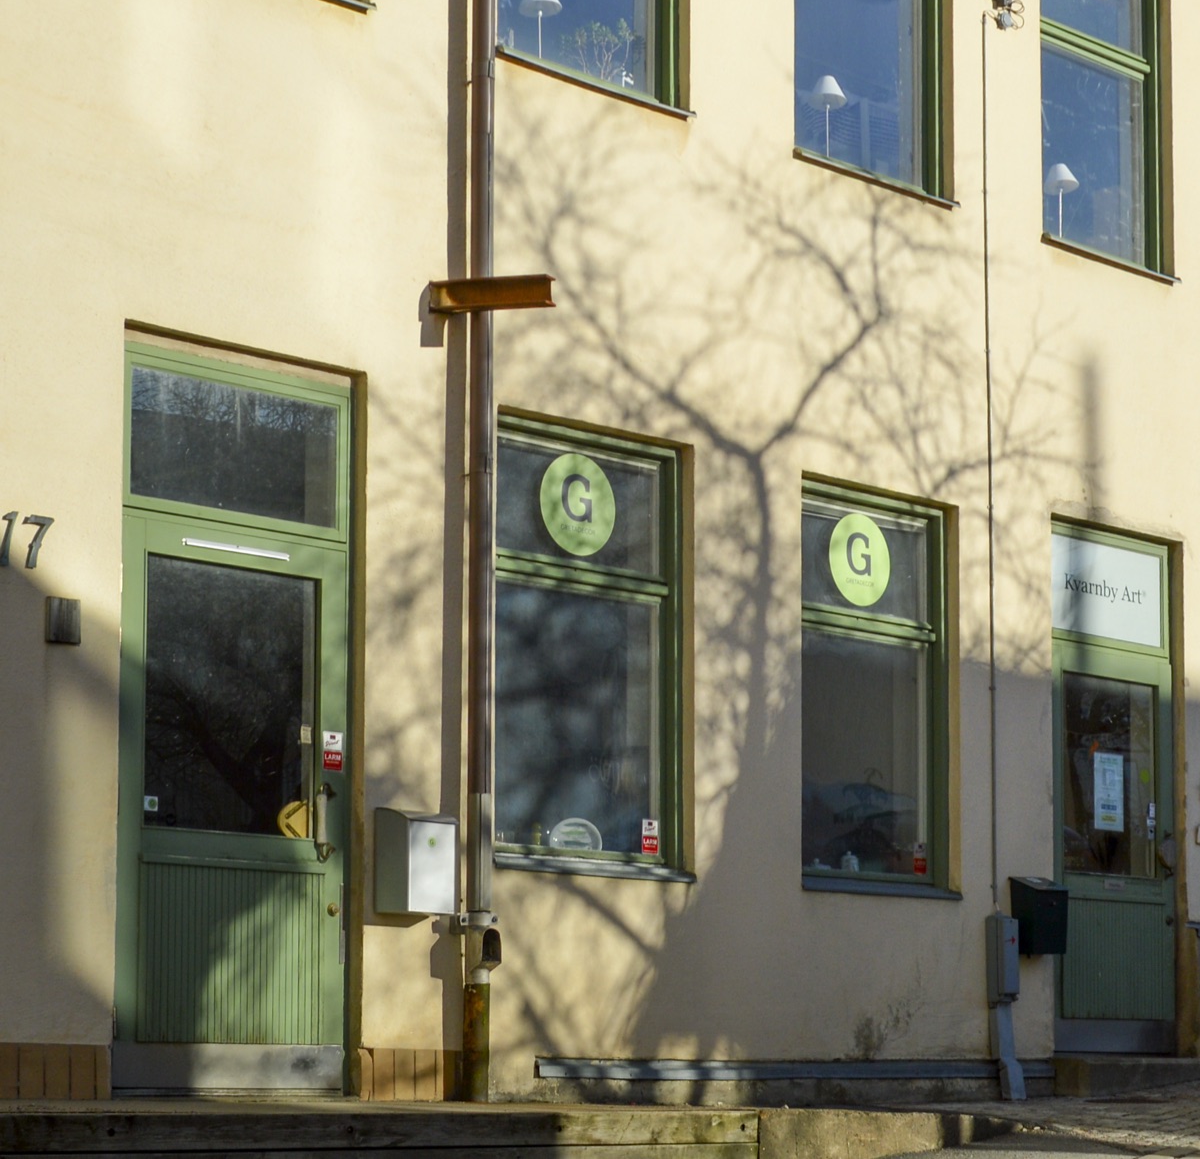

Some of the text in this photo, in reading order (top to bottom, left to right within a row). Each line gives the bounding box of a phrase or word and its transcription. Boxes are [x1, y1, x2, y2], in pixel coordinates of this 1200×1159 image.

[561, 473, 593, 523] G
[0, 511, 55, 569] 17
[846, 532, 871, 576] G
[1064, 573, 1142, 604] Kvarnby Art
[324, 753, 341, 761] LARM
